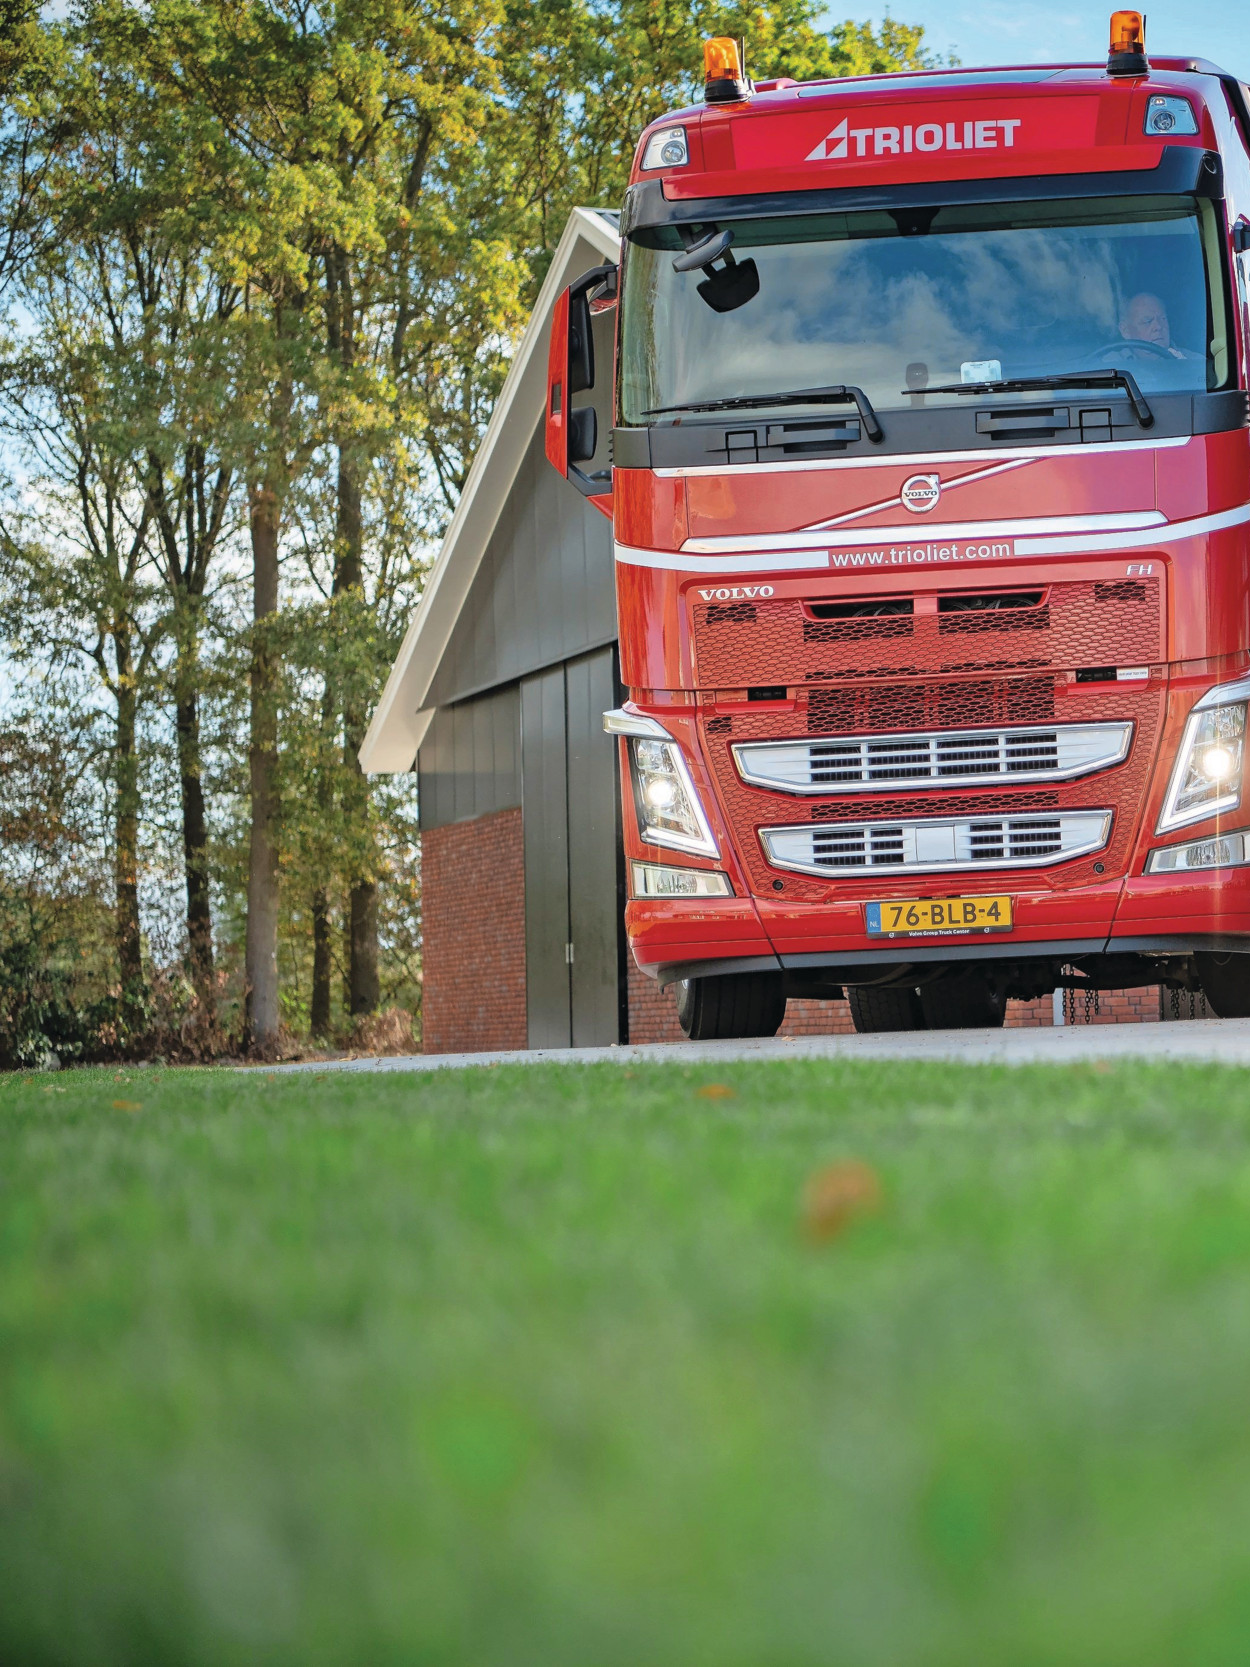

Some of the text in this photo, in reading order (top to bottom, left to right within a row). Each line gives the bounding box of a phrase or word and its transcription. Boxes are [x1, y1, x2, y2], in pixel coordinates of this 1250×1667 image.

[849, 118, 1022, 158] TRIOLIET
[903, 490, 938, 498] VOLVO
[832, 543, 1011, 568] www.trioliet.com
[1126, 564, 1153, 576] FH
[697, 585, 775, 601] VOLVO
[889, 900, 1002, 928] 76-BLB-4
[869, 920, 880, 928] NL
